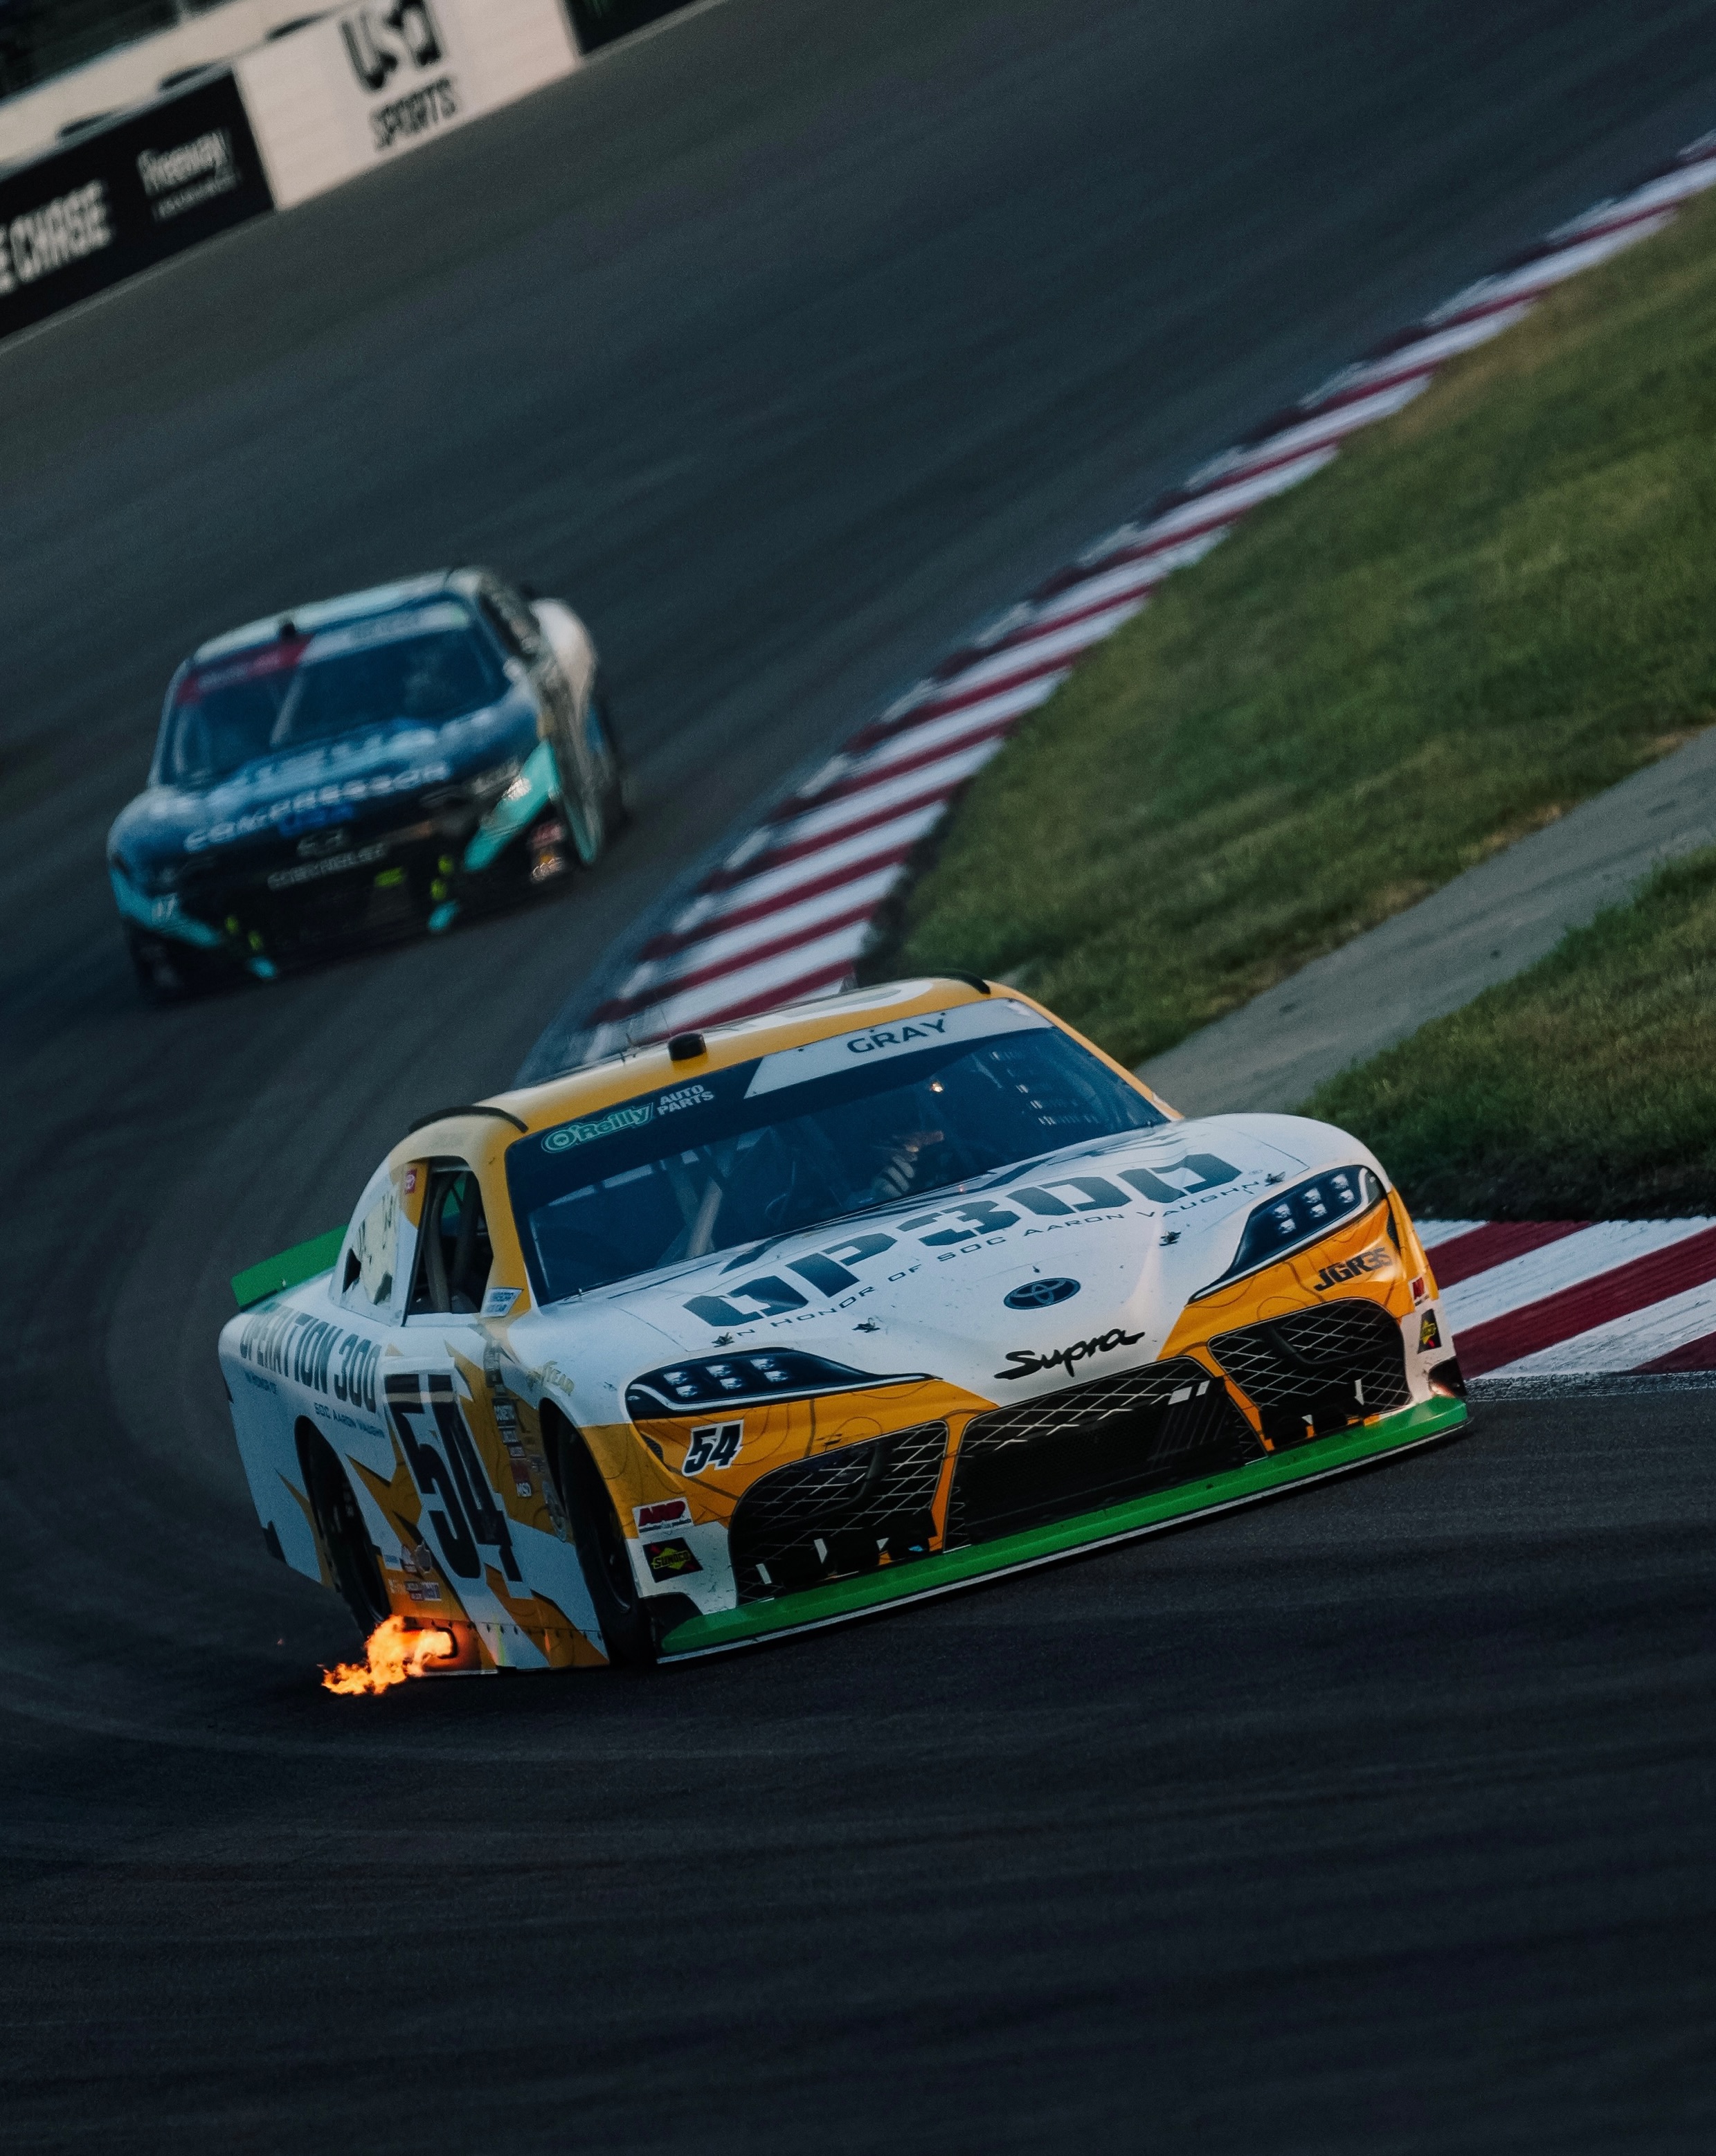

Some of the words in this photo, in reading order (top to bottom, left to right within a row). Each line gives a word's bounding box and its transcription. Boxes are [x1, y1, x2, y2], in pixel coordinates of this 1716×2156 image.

[370, 78, 458, 150] SPORTS
[847, 1018, 946, 1053] GRAY
[656, 1091, 715, 1116] PARTS
[660, 1084, 705, 1105] AUTO
[543, 1104, 653, 1152] O'Reilly
[770, 1285, 876, 1328] HONOR
[888, 1263, 922, 1282] OF
[937, 1236, 1006, 1262] SOC
[1024, 1213, 1126, 1237] AARON
[1137, 1180, 1260, 1217] VAUGHN
[240, 1305, 344, 1395] OPERATION
[334, 1333, 383, 1414] 300
[993, 1328, 1146, 1380] Supra
[683, 1421, 743, 1476] 54
[384, 1373, 523, 1582] 54
[638, 1500, 686, 1527] ARP
[653, 1551, 691, 1568] SUNOCO
